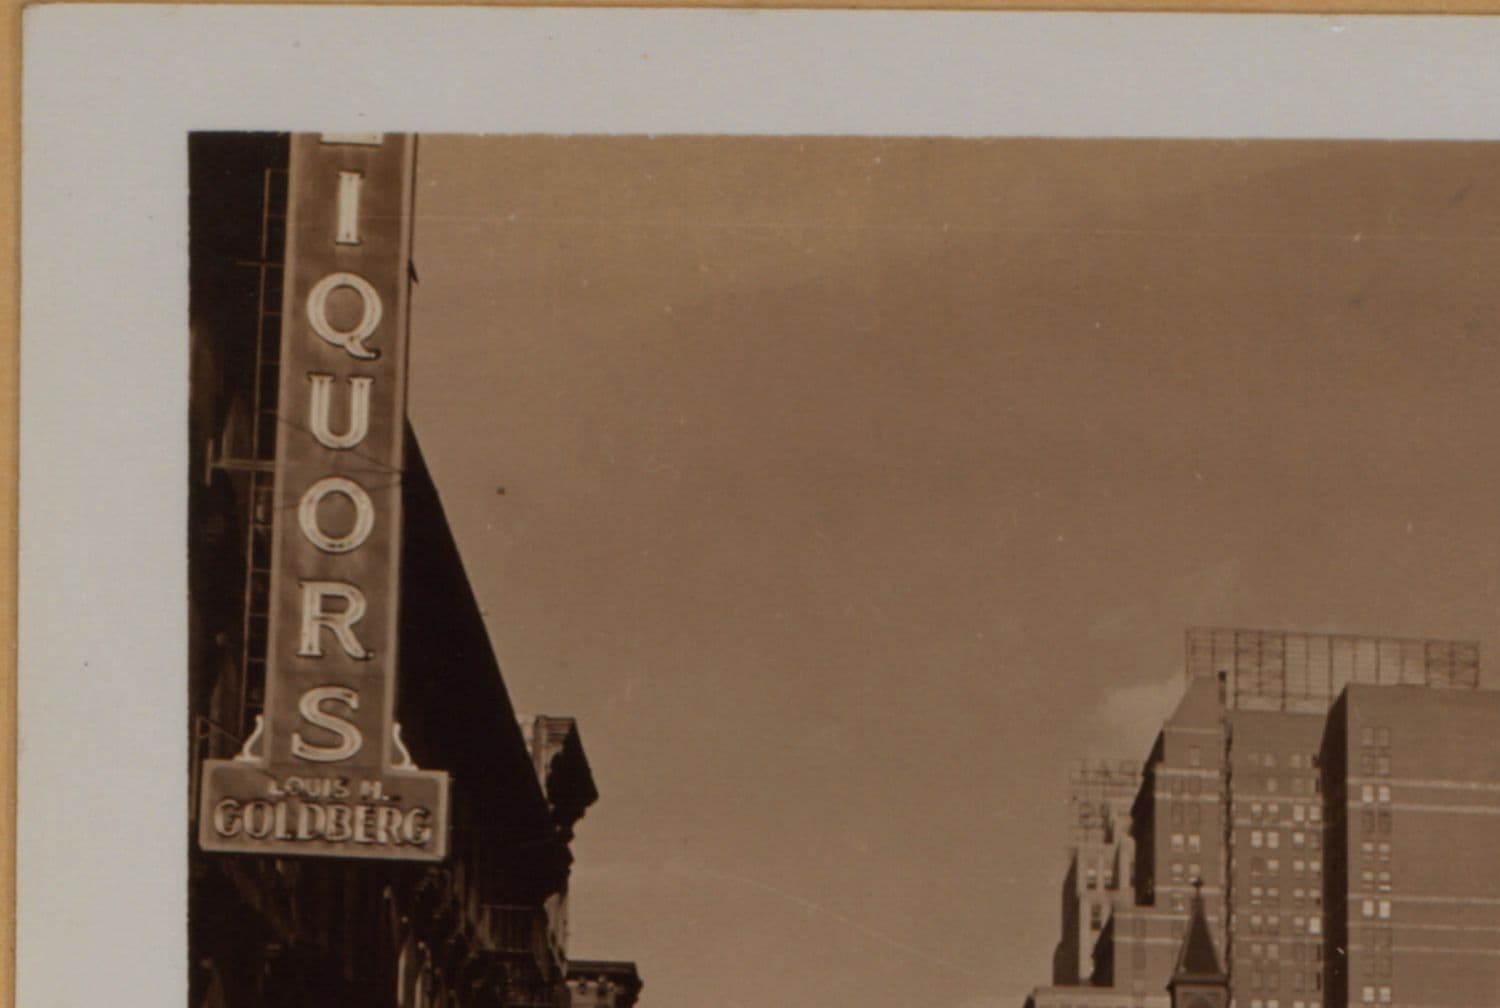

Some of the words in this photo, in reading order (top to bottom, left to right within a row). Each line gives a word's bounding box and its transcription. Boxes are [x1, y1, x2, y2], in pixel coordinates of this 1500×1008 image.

[291, 131, 384, 764] IQUORS
[268, 775, 350, 798] LOUIS
[213, 798, 433, 844] GOLDBERG
